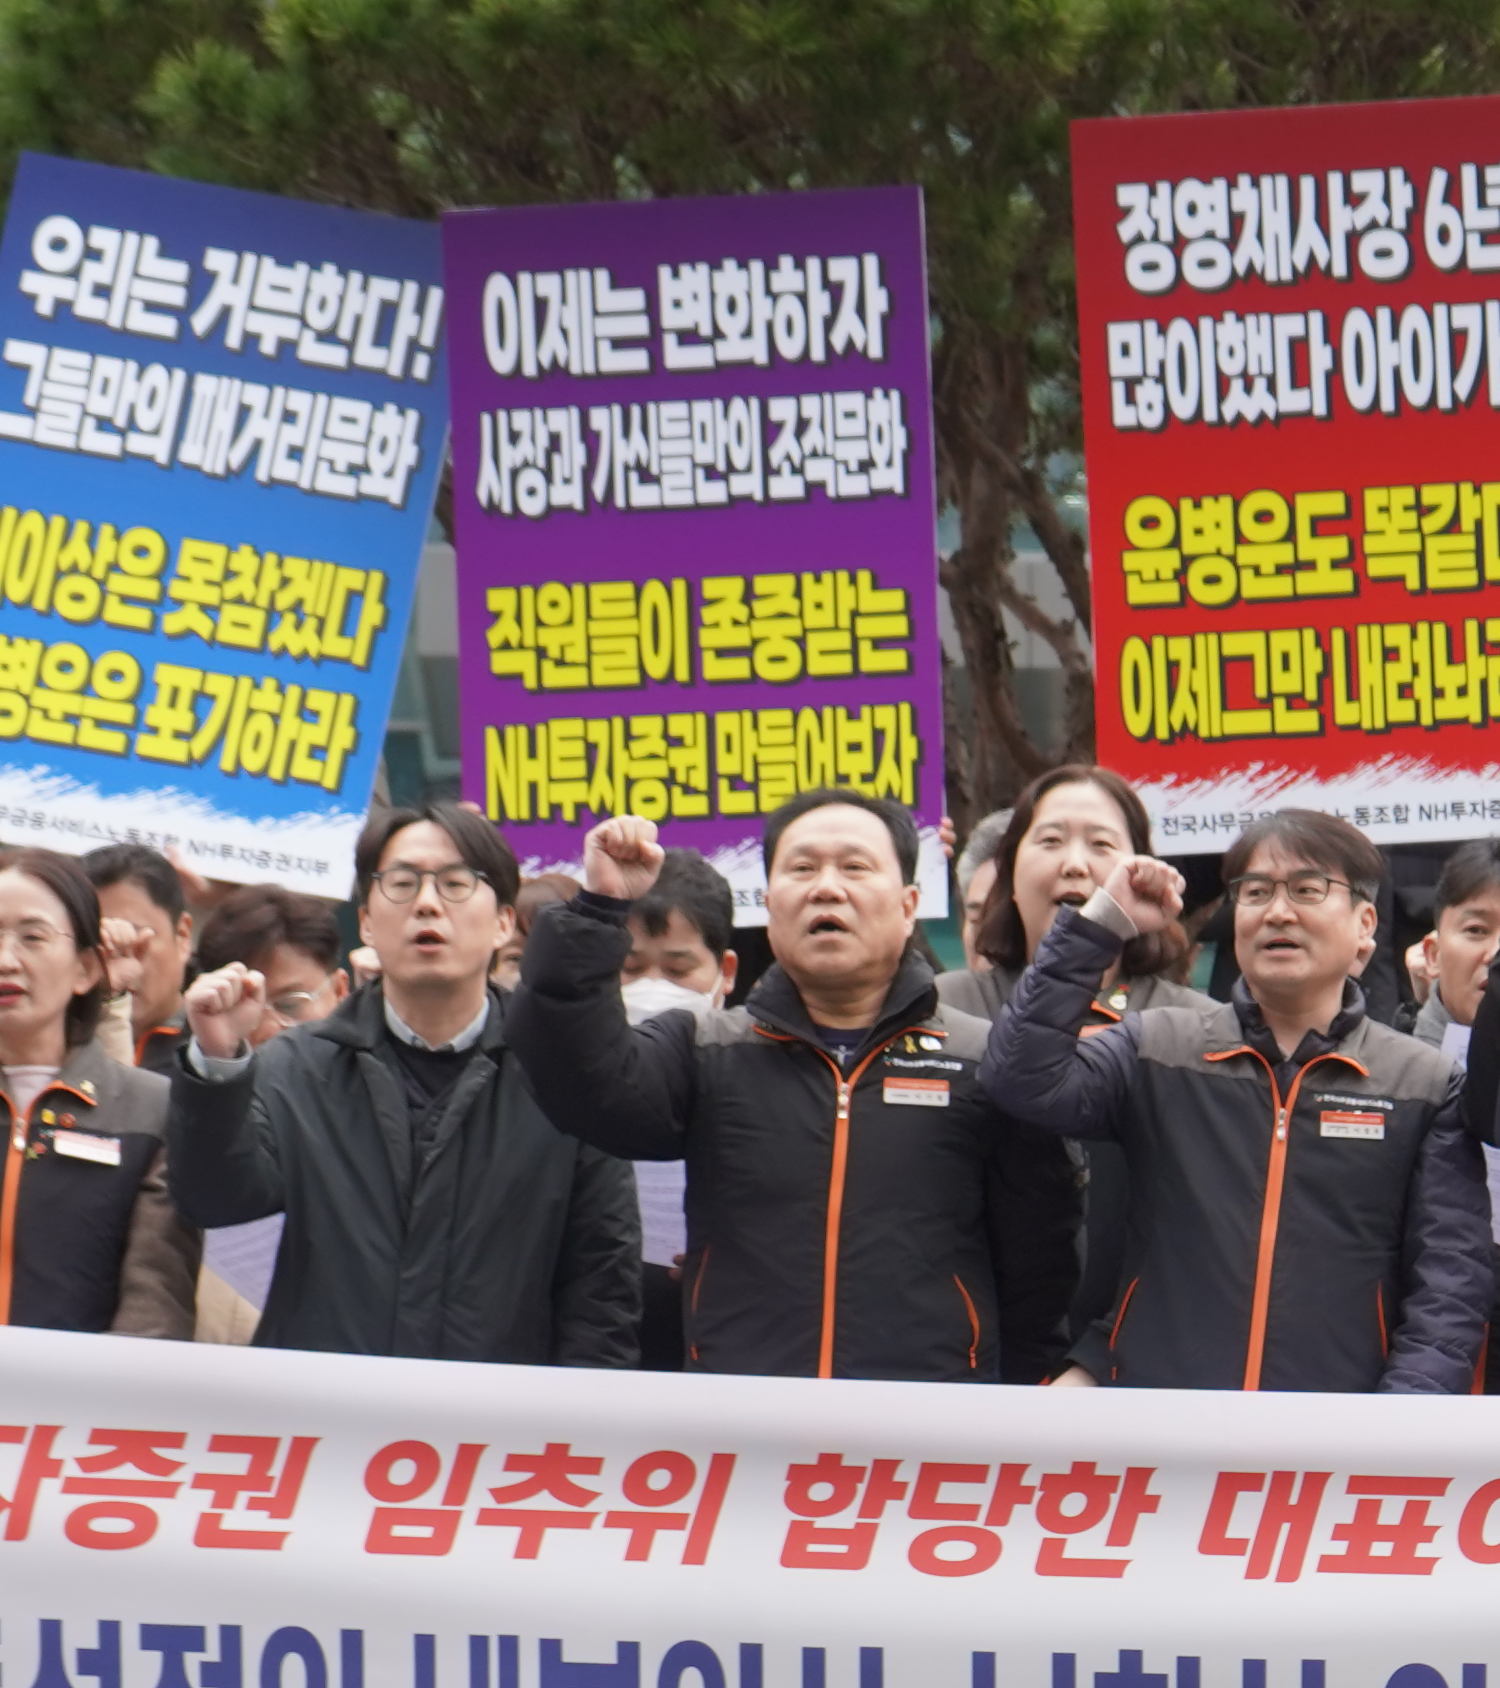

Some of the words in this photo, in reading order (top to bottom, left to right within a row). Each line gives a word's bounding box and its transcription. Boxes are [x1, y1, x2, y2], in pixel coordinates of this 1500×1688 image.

[1116, 167, 1414, 293] 정영채사장
[18, 215, 190, 339] 우리는
[189, 247, 444, 381] 거부한다!
[482, 268, 651, 378] 이제는
[658, 253, 889, 370] 변화하자
[1107, 310, 1334, 429] 많이했다
[177, 372, 420, 506] 패거리문화
[476, 405, 587, 517] 사장과
[589, 396, 764, 509] 가신들만의
[767, 387, 908, 500] 조직문화
[162, 537, 385, 668] 못참겠다
[1121, 489, 1355, 606] 윤병운도
[485, 577, 690, 691] 직원들이
[697, 568, 910, 682] 존중받는
[1120, 627, 1324, 741] 이제그만
[135, 662, 356, 791] 포기하라
[484, 711, 710, 824] NH투자증권
[714, 700, 919, 815] 만들어보자
[188, 839, 332, 877] NH투자증권지부
[362, 1438, 738, 1567] 임추위
[778, 1451, 1160, 1580] 합당한
